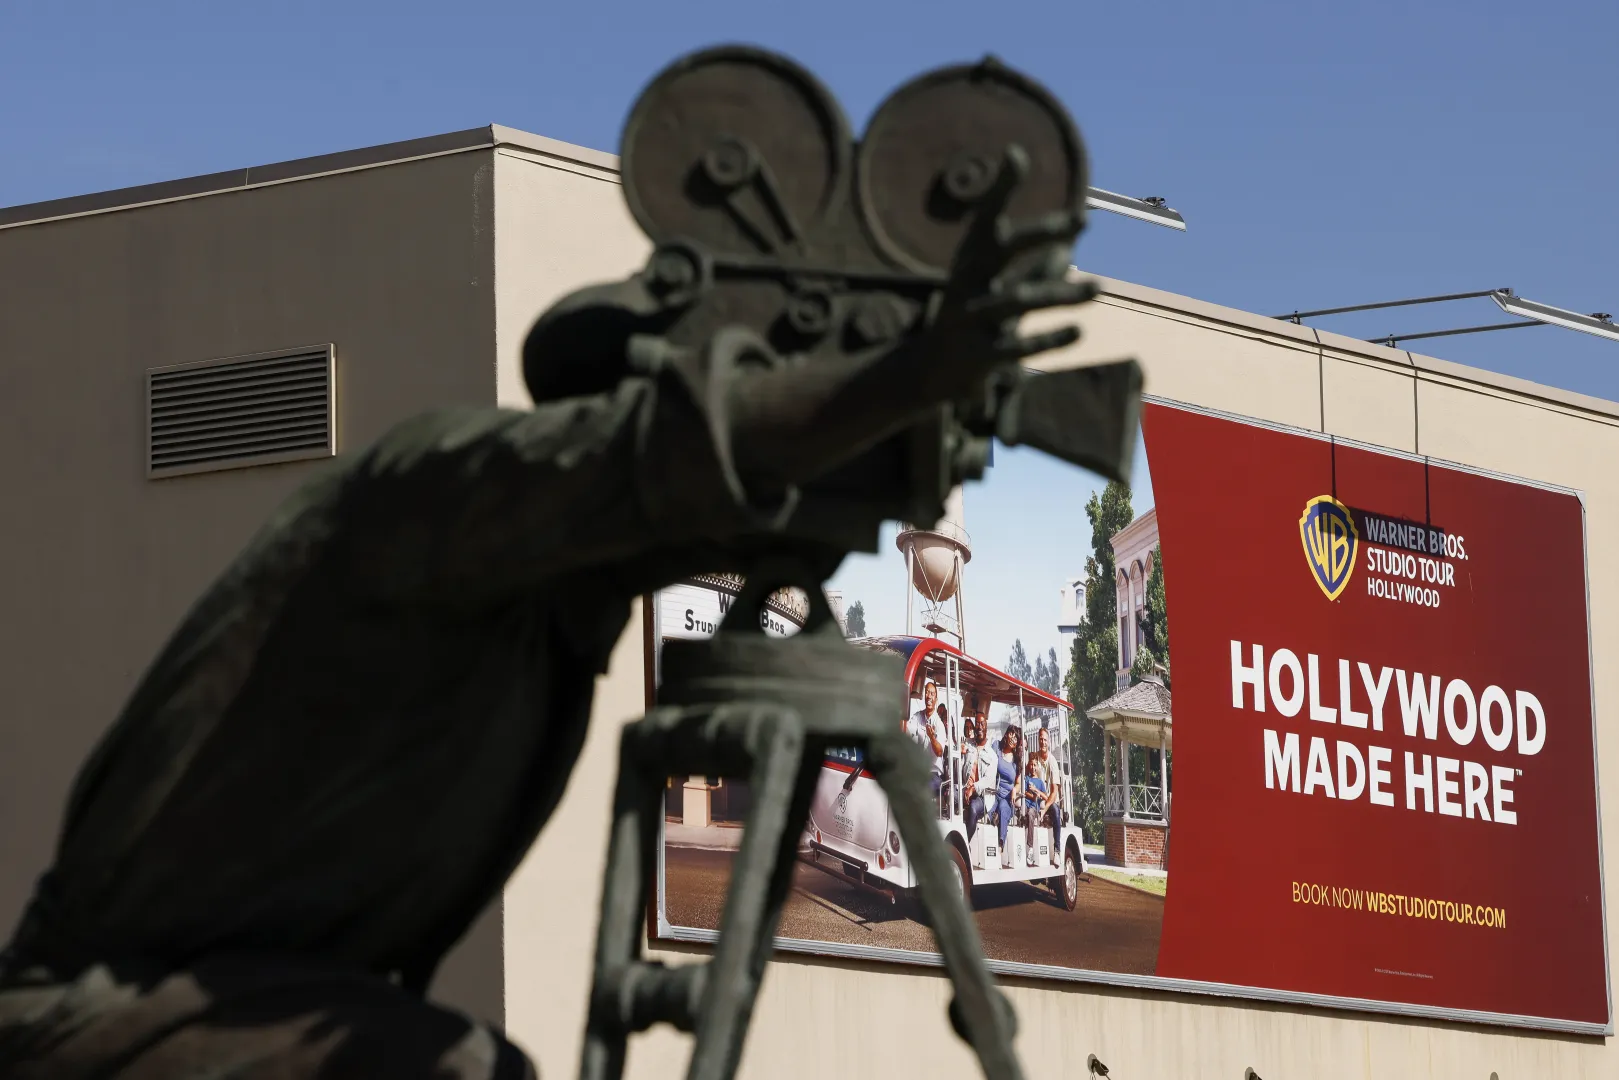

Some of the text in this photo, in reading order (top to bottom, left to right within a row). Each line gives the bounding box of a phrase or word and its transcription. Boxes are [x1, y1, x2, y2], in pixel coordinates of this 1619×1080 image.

[1365, 516, 1469, 561] WARNER BROS.
[1367, 547, 1456, 588] STUDIO TOUR
[1367, 577, 1441, 609] HOLLYWOOD
[1230, 639, 1547, 756] HOLLYWOOD
[1263, 728, 1395, 808] MADE
[1292, 881, 1506, 929] BOOK NOW WBSTUDIOTOUR.COM
